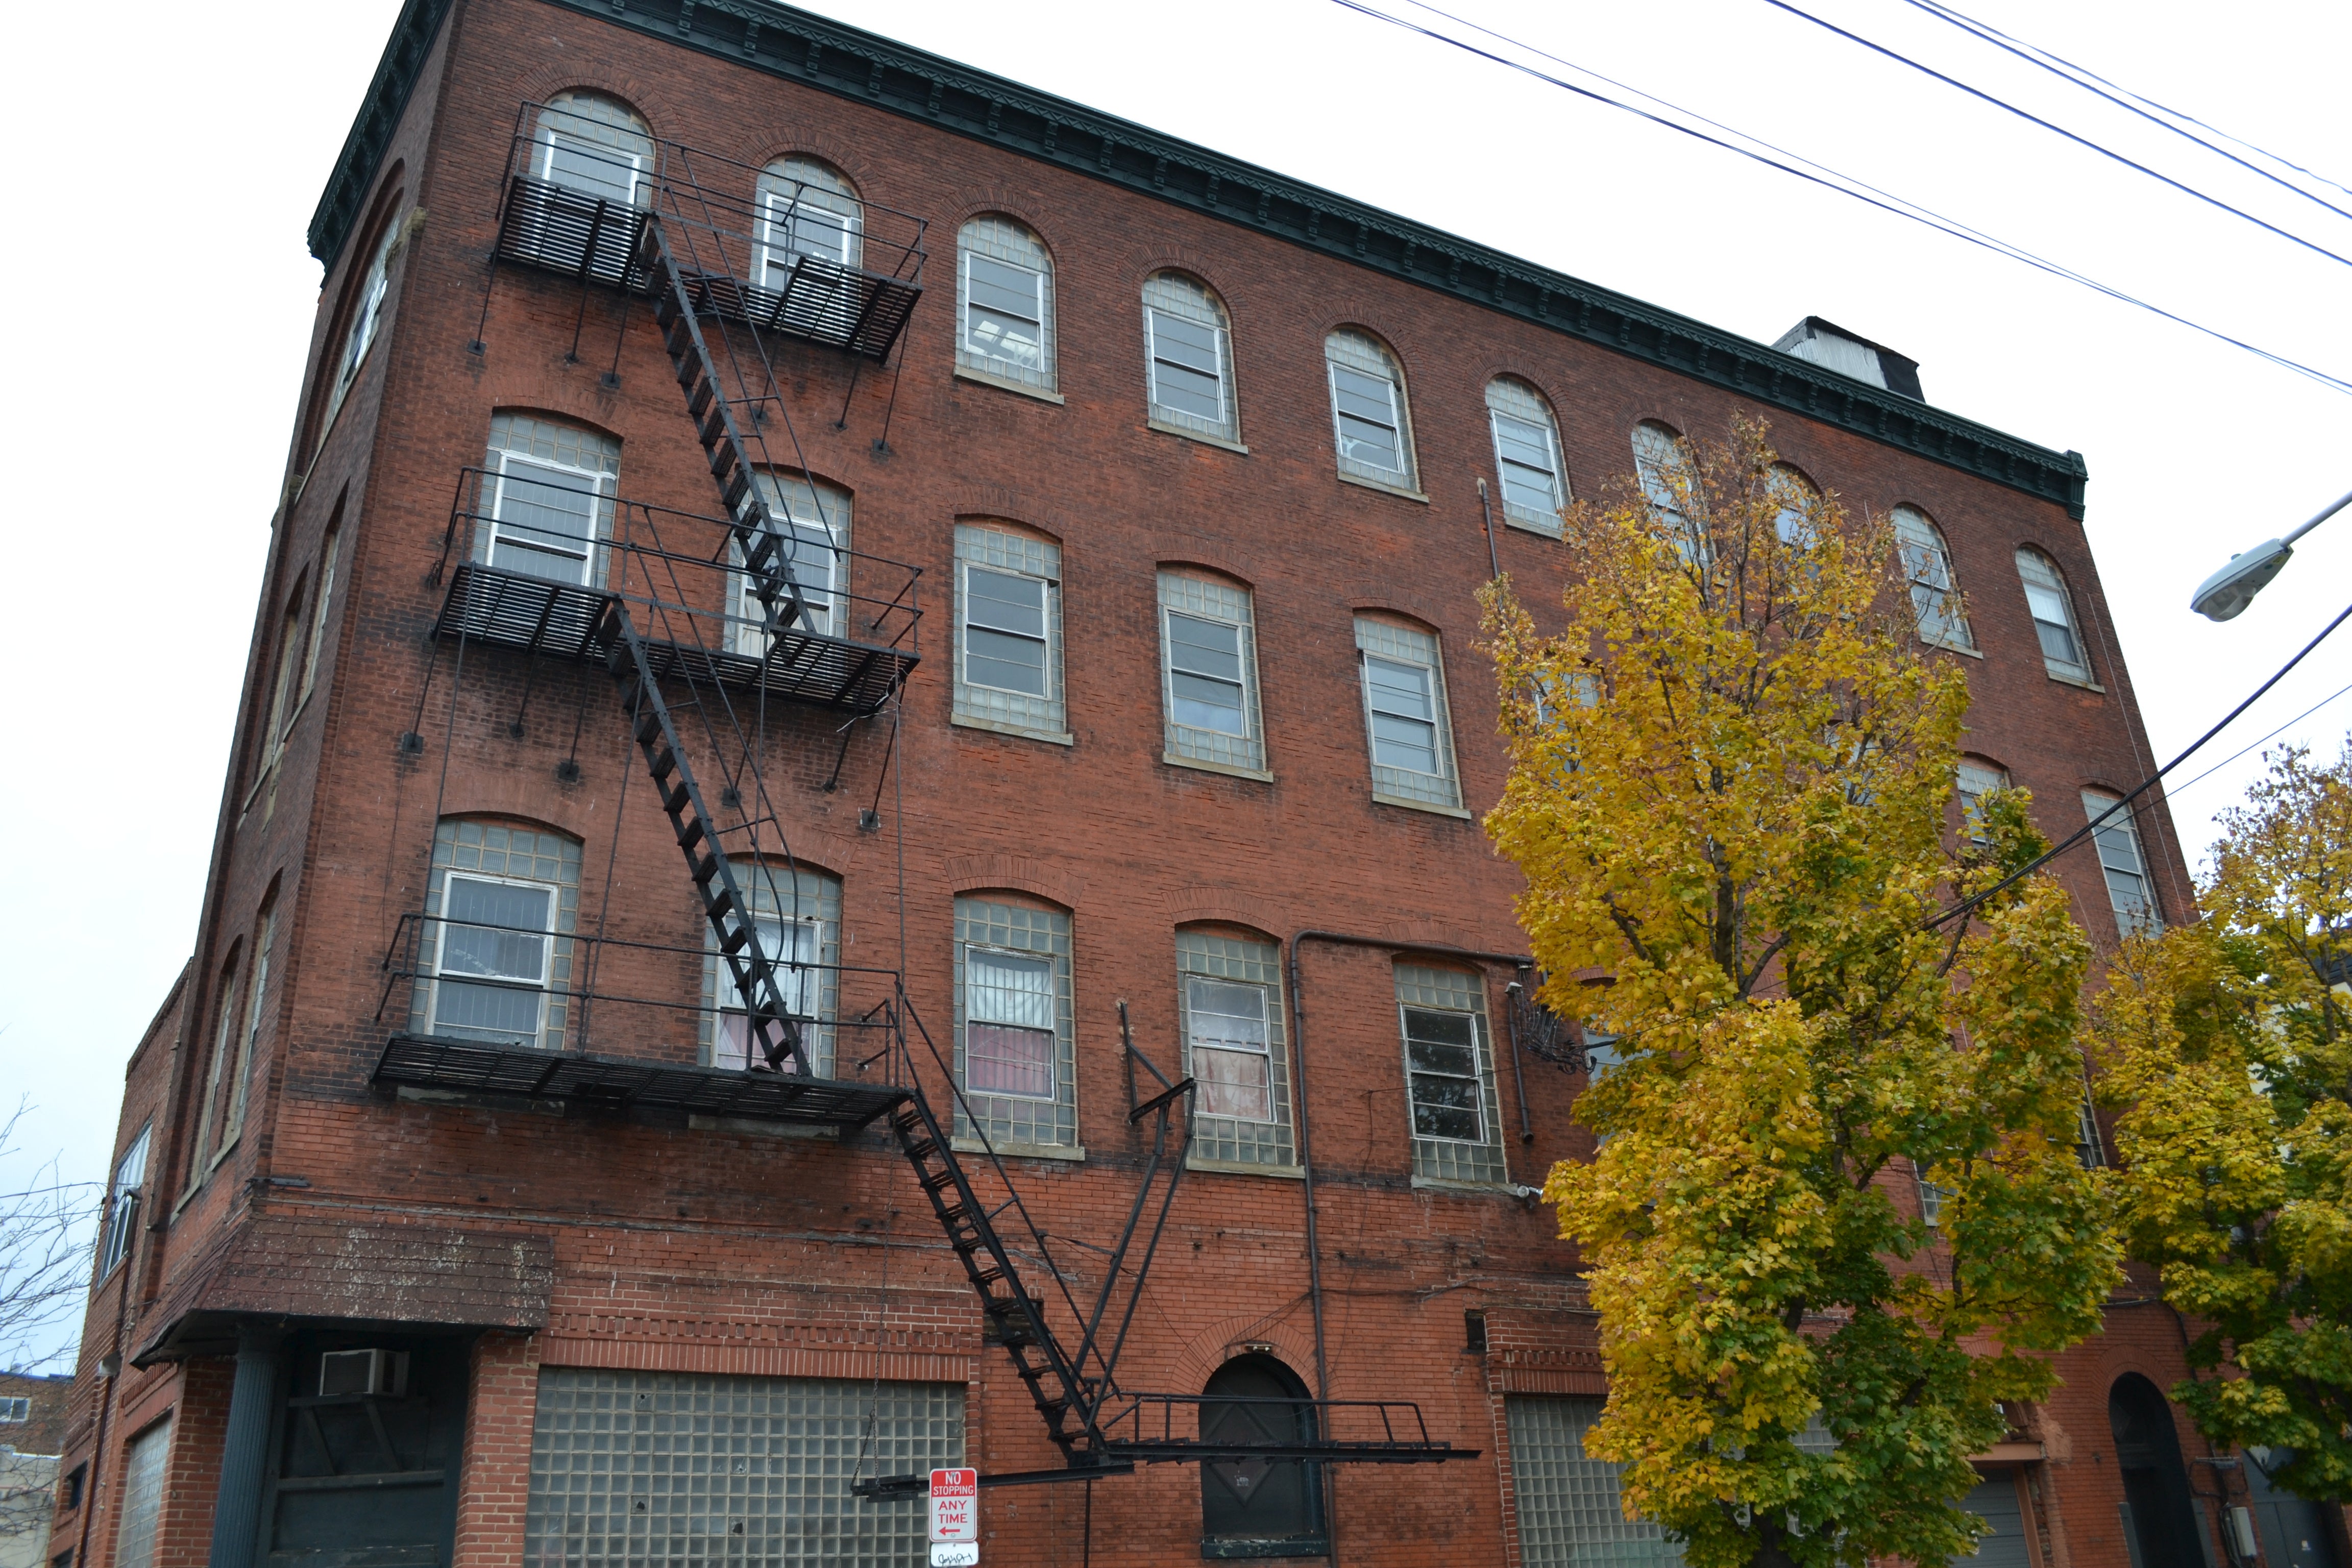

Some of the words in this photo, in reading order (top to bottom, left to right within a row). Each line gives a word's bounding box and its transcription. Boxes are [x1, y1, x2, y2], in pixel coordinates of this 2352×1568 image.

[945, 1472, 961, 1485] NO
[933, 1485, 973, 1496] STOPPING
[938, 1500, 967, 1510] ANY
[938, 1513, 968, 1524] TIME
